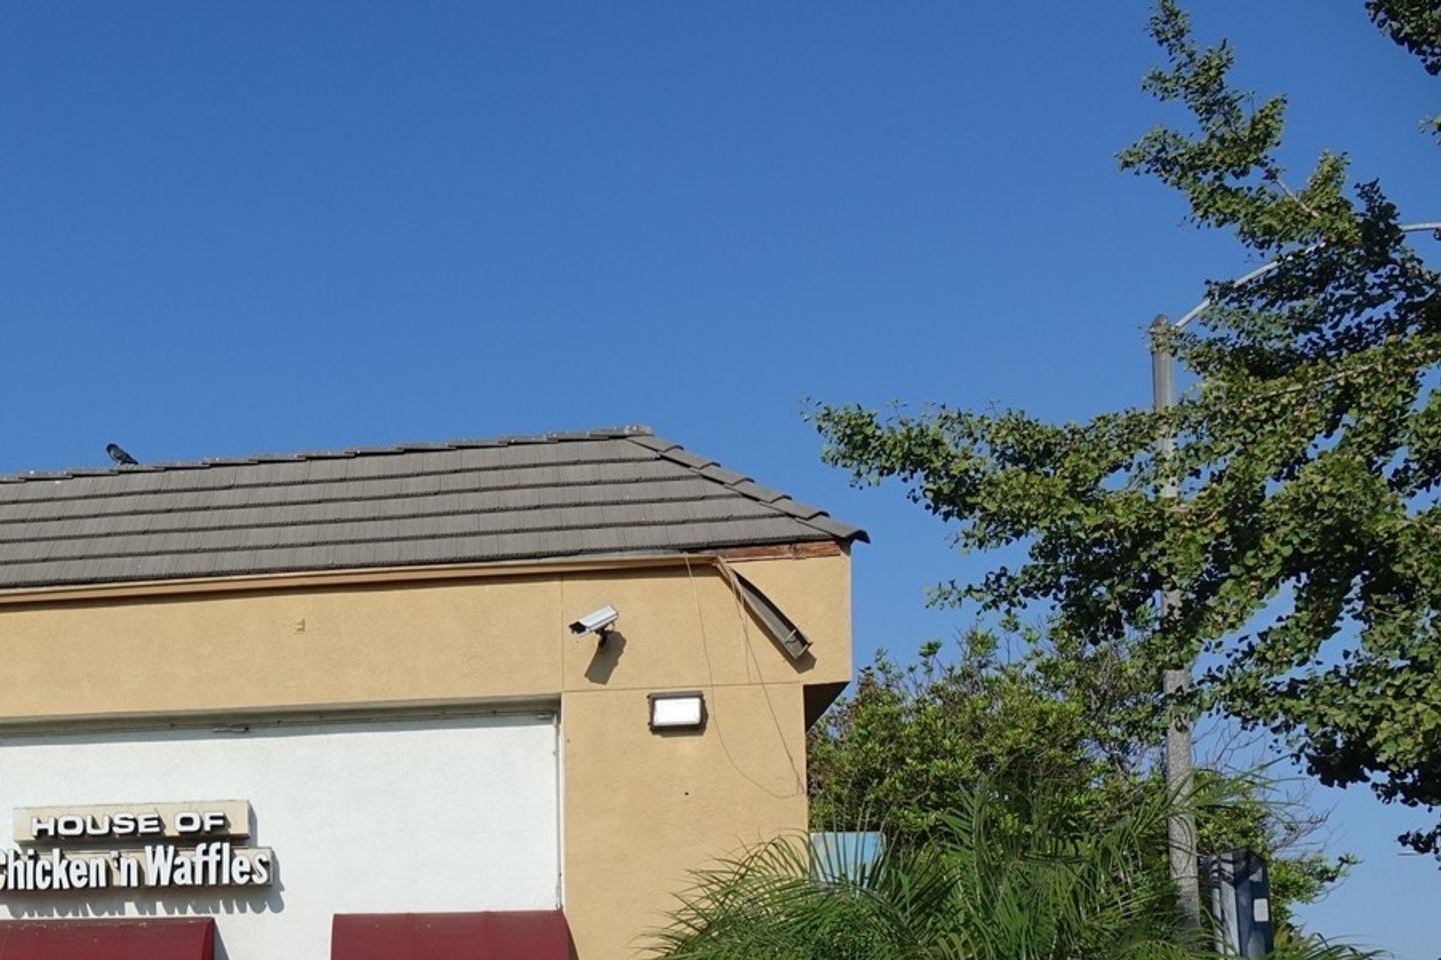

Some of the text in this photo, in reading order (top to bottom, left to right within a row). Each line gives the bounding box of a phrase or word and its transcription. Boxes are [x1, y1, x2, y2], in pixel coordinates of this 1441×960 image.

[32, 811, 225, 836] HOUSE OF
[145, 842, 271, 886] Waffles
